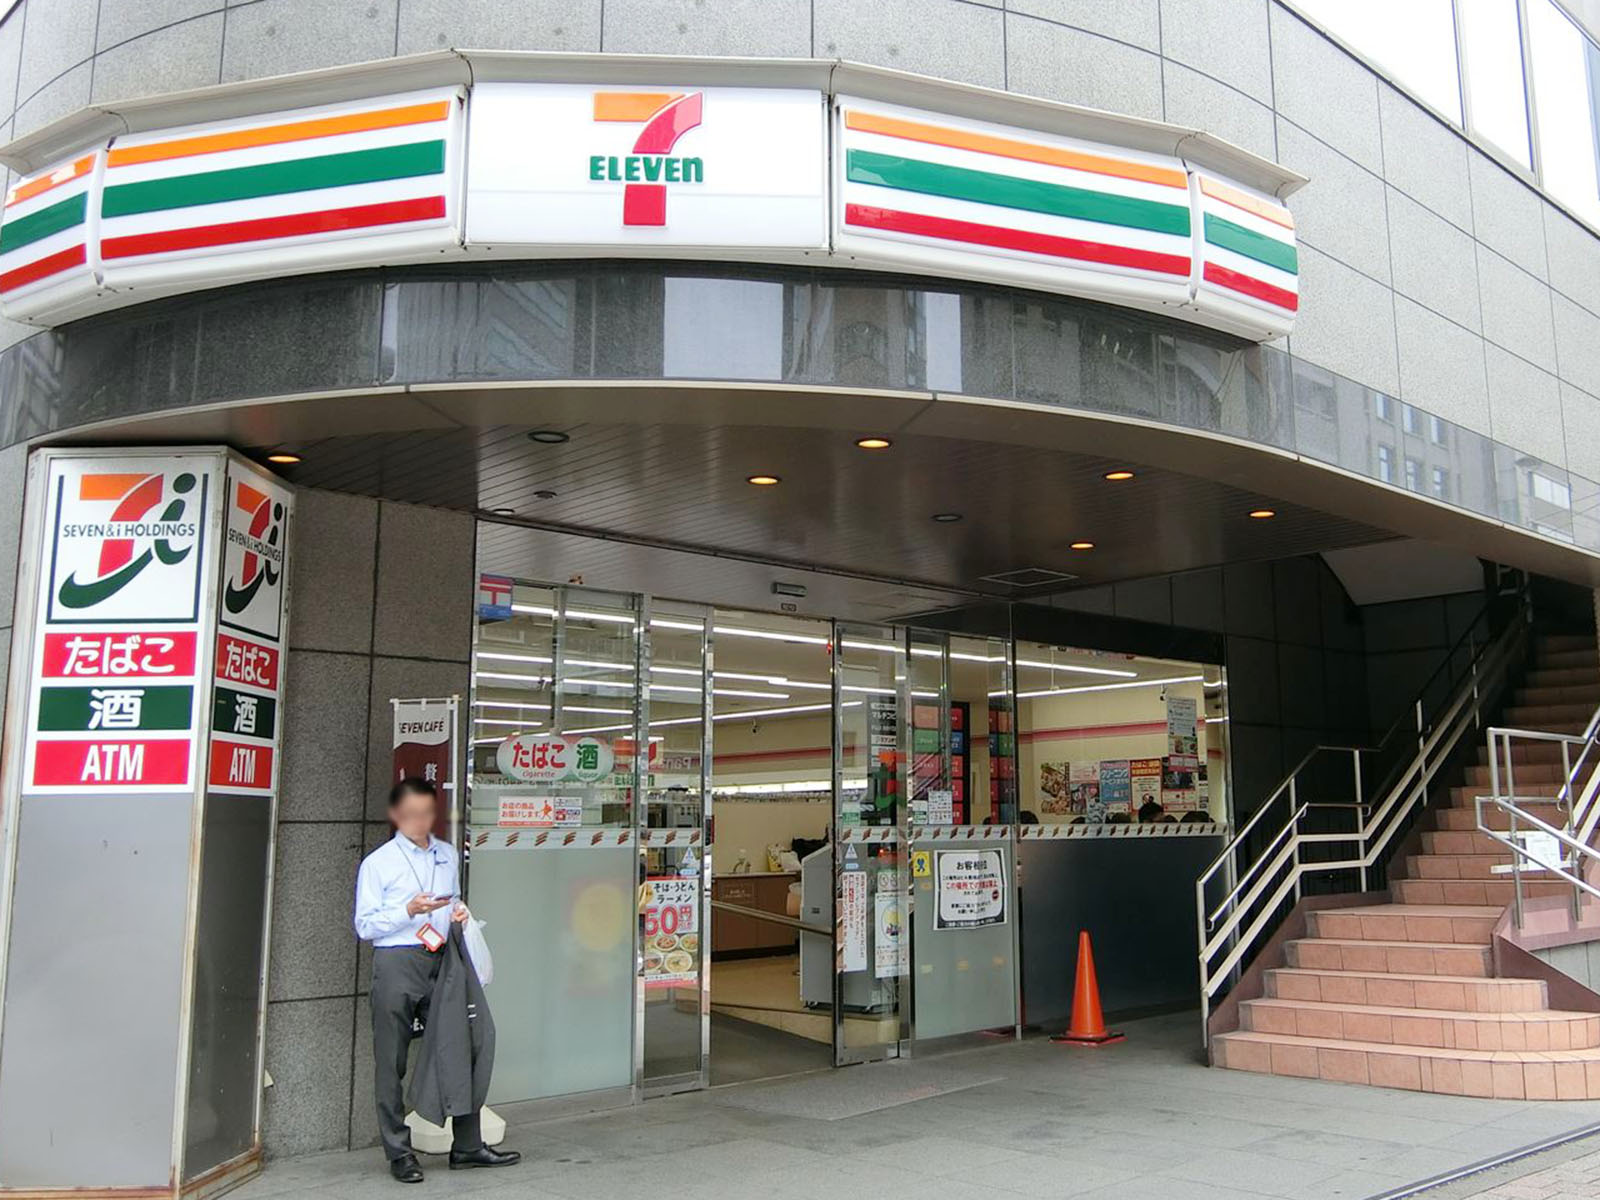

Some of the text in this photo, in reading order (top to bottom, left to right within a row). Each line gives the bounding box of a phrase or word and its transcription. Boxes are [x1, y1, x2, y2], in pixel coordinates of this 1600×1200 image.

[125, 522, 196, 537] HOLDINGS
[253, 540, 282, 563] HOLDINGS
[62, 635, 175, 675] たばこ
[225, 641, 271, 685] たばこ
[88, 688, 145, 729] 酒
[234, 694, 258, 733] 酒
[80, 744, 145, 781] ATM
[229, 747, 257, 783] ATM
[512, 742, 599, 770] たばこ 酒
[657, 894, 692, 905] ラーメン
